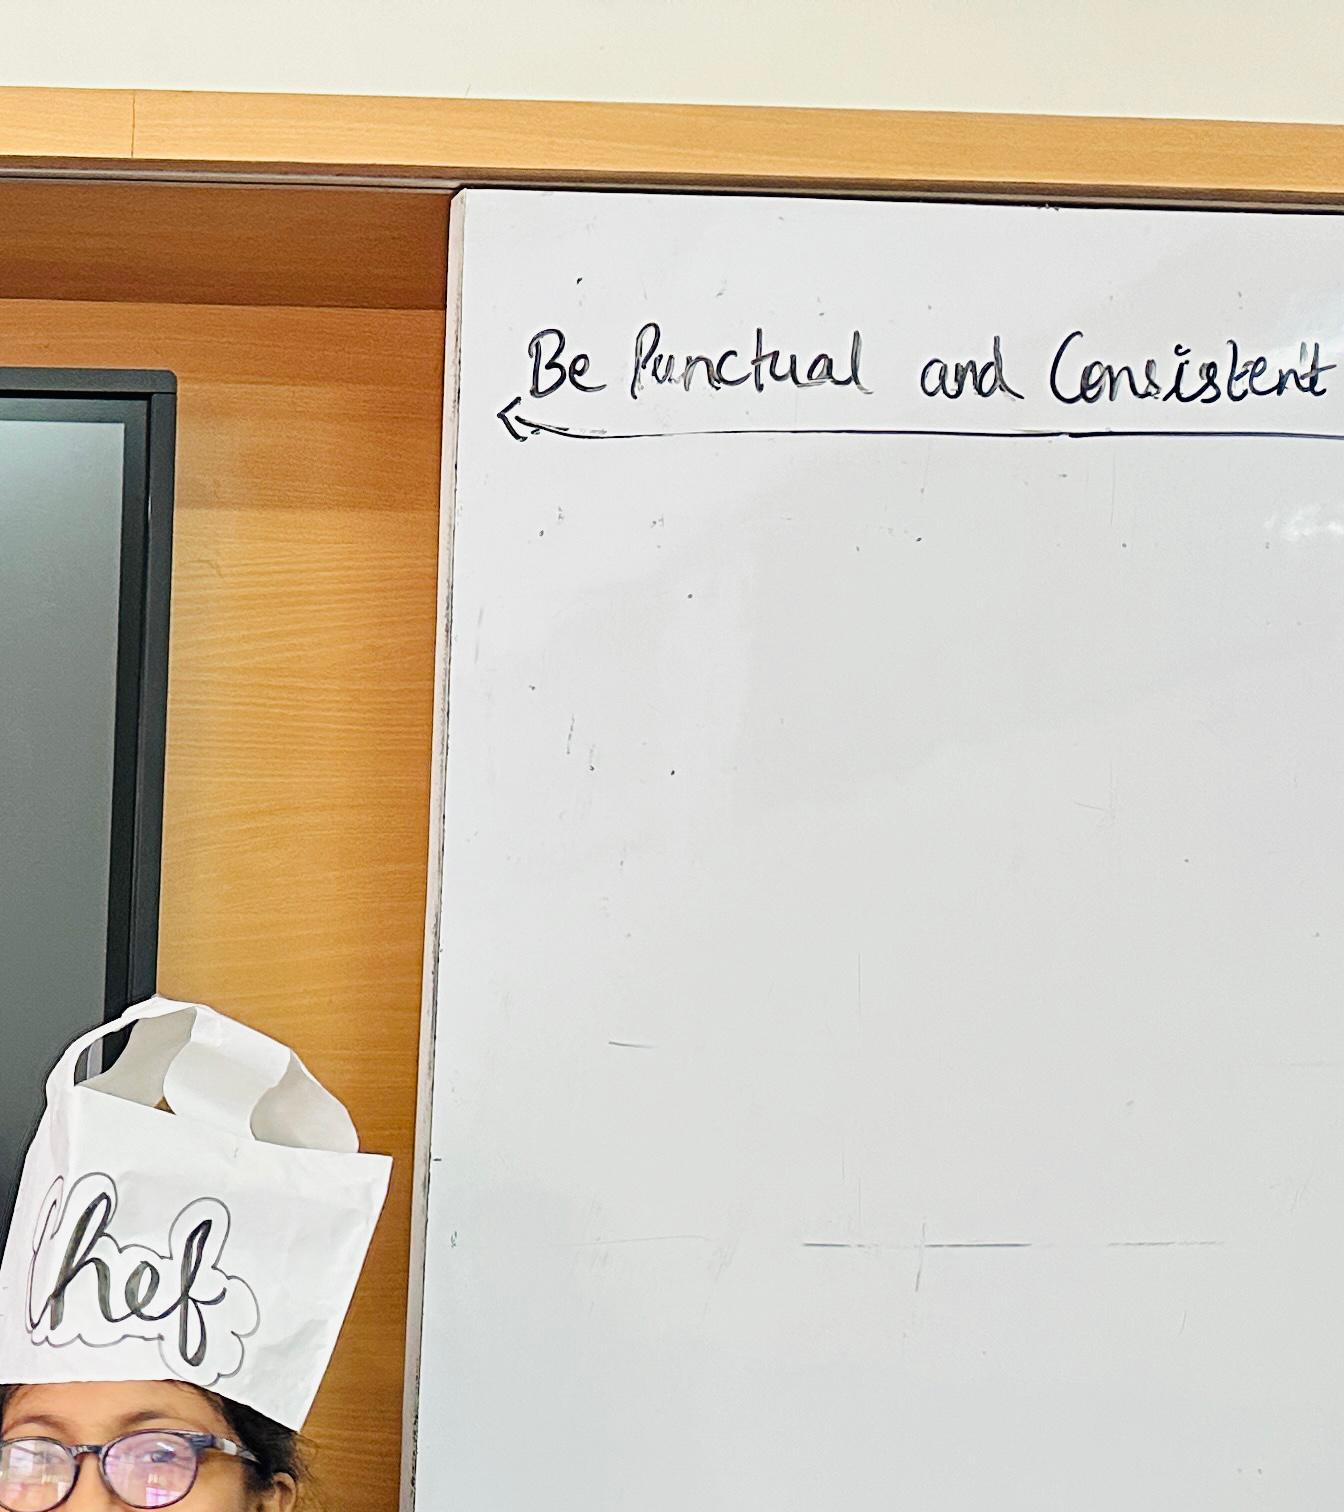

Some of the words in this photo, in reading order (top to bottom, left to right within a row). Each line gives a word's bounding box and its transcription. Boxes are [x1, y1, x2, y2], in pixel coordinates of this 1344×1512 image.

[527, 328, 608, 399] Be
[630, 322, 872, 400] Punctual
[919, 334, 1026, 403] and
